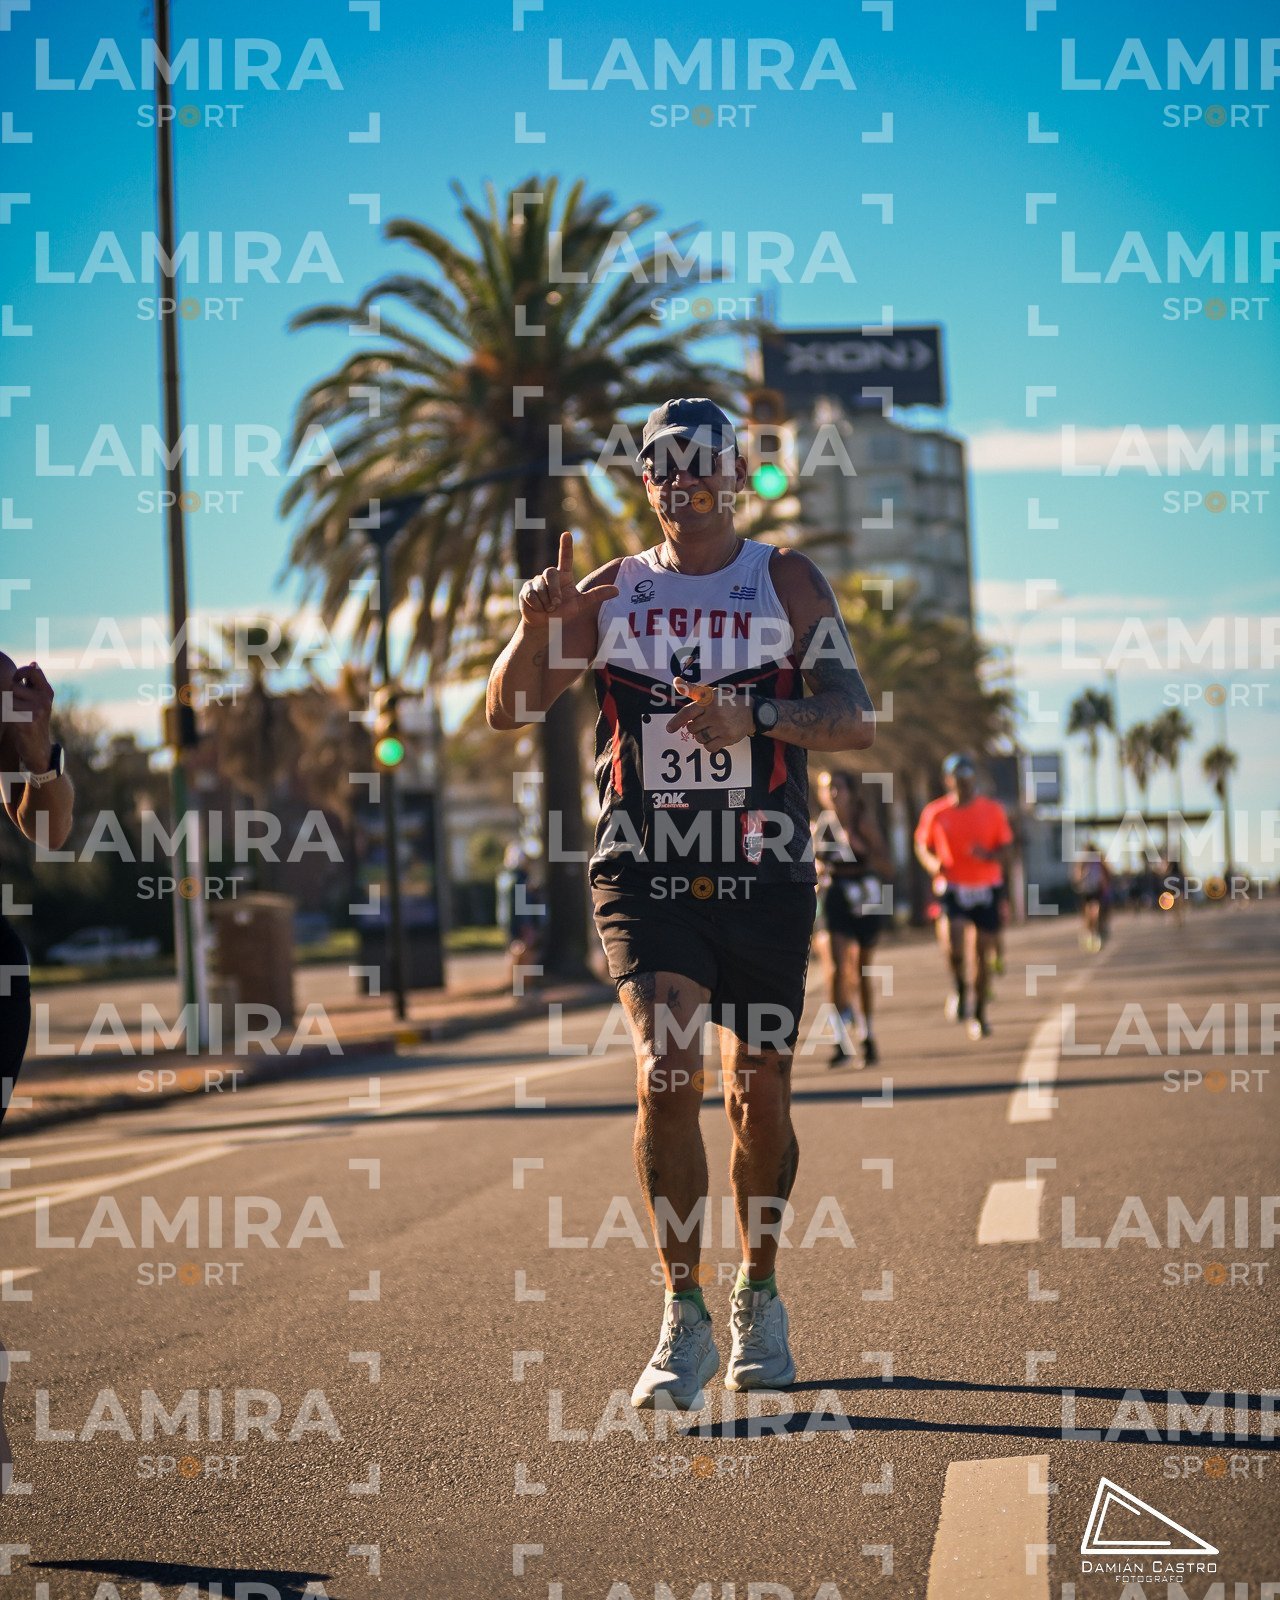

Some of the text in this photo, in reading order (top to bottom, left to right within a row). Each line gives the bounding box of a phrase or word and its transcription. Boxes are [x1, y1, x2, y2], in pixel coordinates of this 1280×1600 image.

[628, 608, 752, 640] LEGION
[660, 748, 733, 784] 319
[651, 792, 686, 809] 30K
